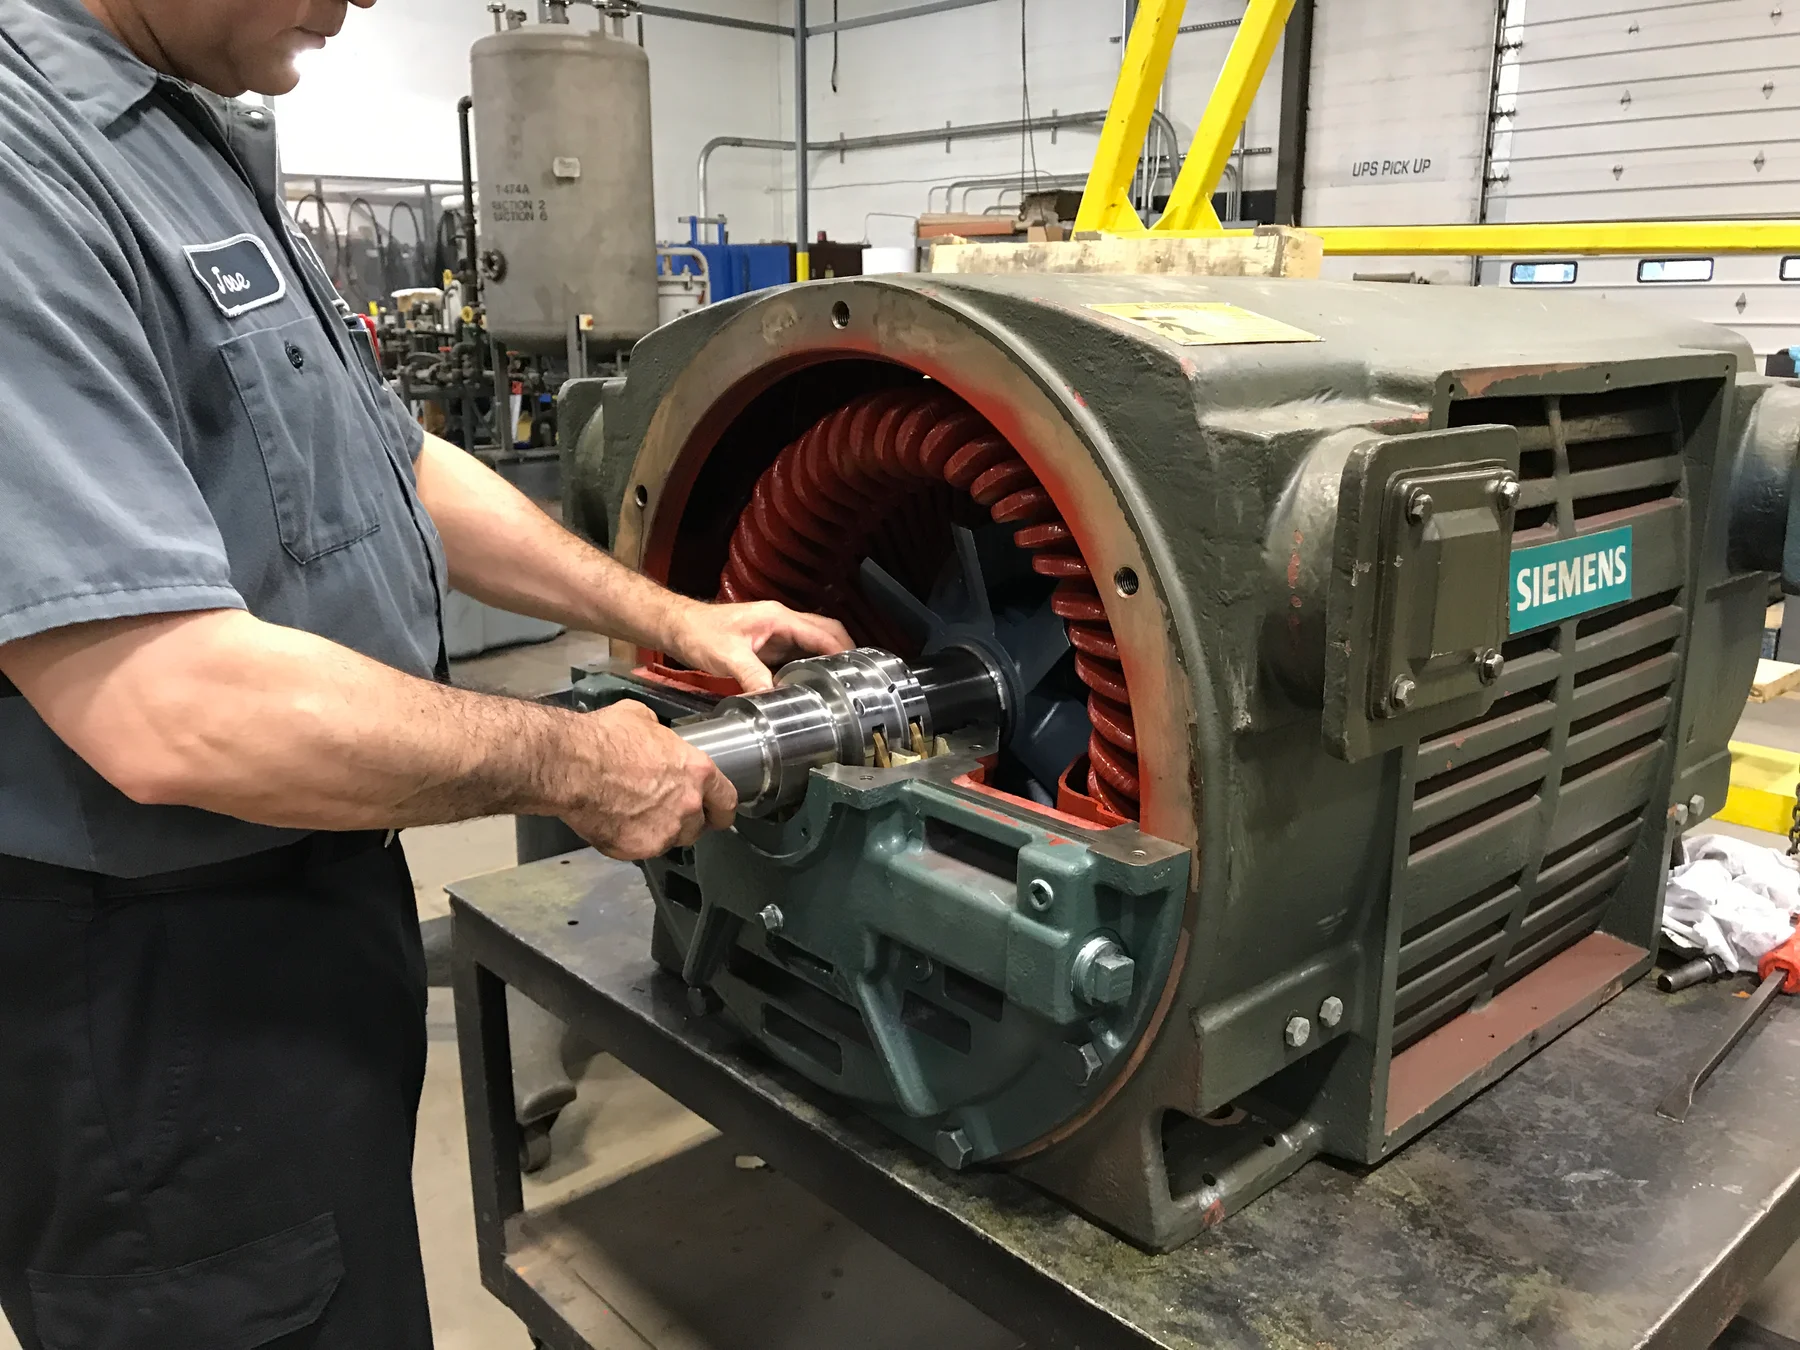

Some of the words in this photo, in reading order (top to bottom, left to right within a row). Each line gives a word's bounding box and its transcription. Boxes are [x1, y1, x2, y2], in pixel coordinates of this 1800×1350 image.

[1352, 161, 1378, 177] UPS
[1382, 160, 1410, 175] PICK
[1413, 158, 1431, 174] UP
[538, 200, 546, 210] 2
[211, 266, 250, 294] Jose
[1516, 545, 1627, 612] SIEMENS
